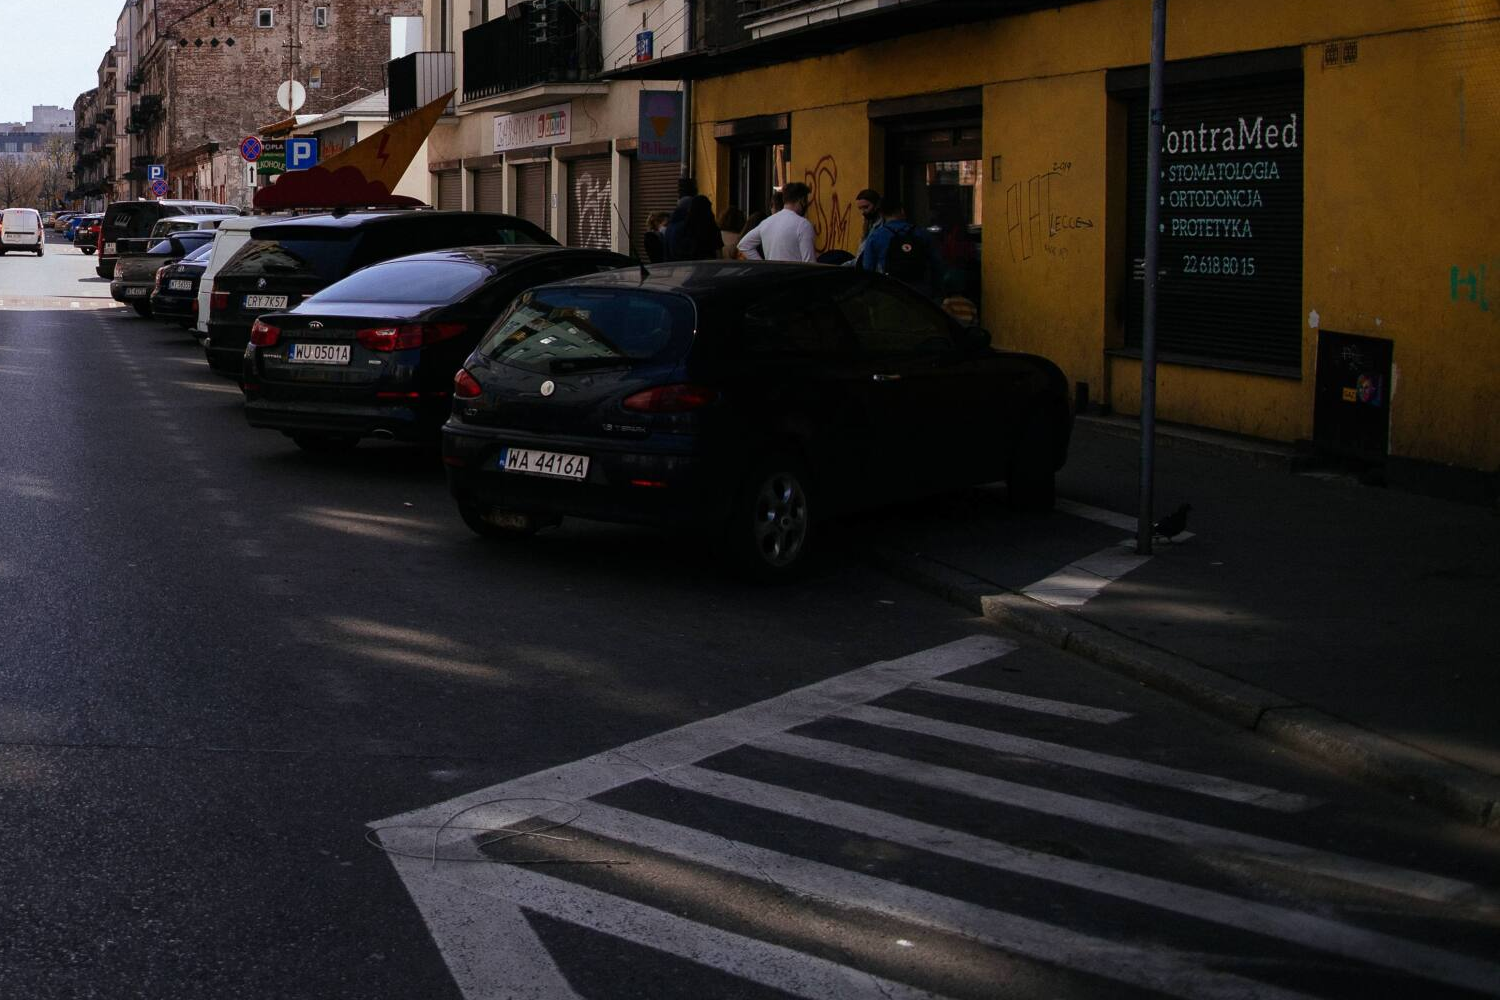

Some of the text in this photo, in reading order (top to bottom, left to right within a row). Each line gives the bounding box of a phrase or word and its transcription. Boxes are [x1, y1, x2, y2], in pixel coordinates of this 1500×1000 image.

[293, 142, 311, 166] P
[151, 167, 161, 179] P
[257, 160, 286, 171] LKOHOLE
[1168, 161, 1281, 182] STOMATOLOGIA
[1169, 189, 1263, 208] ORTODONCJA
[1171, 218, 1253, 238] PROTETYKA
[1182, 255, 1256, 276] 22 618 80 15
[296, 346, 312, 359] WU
[314, 346, 348, 360] 0501A
[508, 450, 584, 477] WA 4416A
